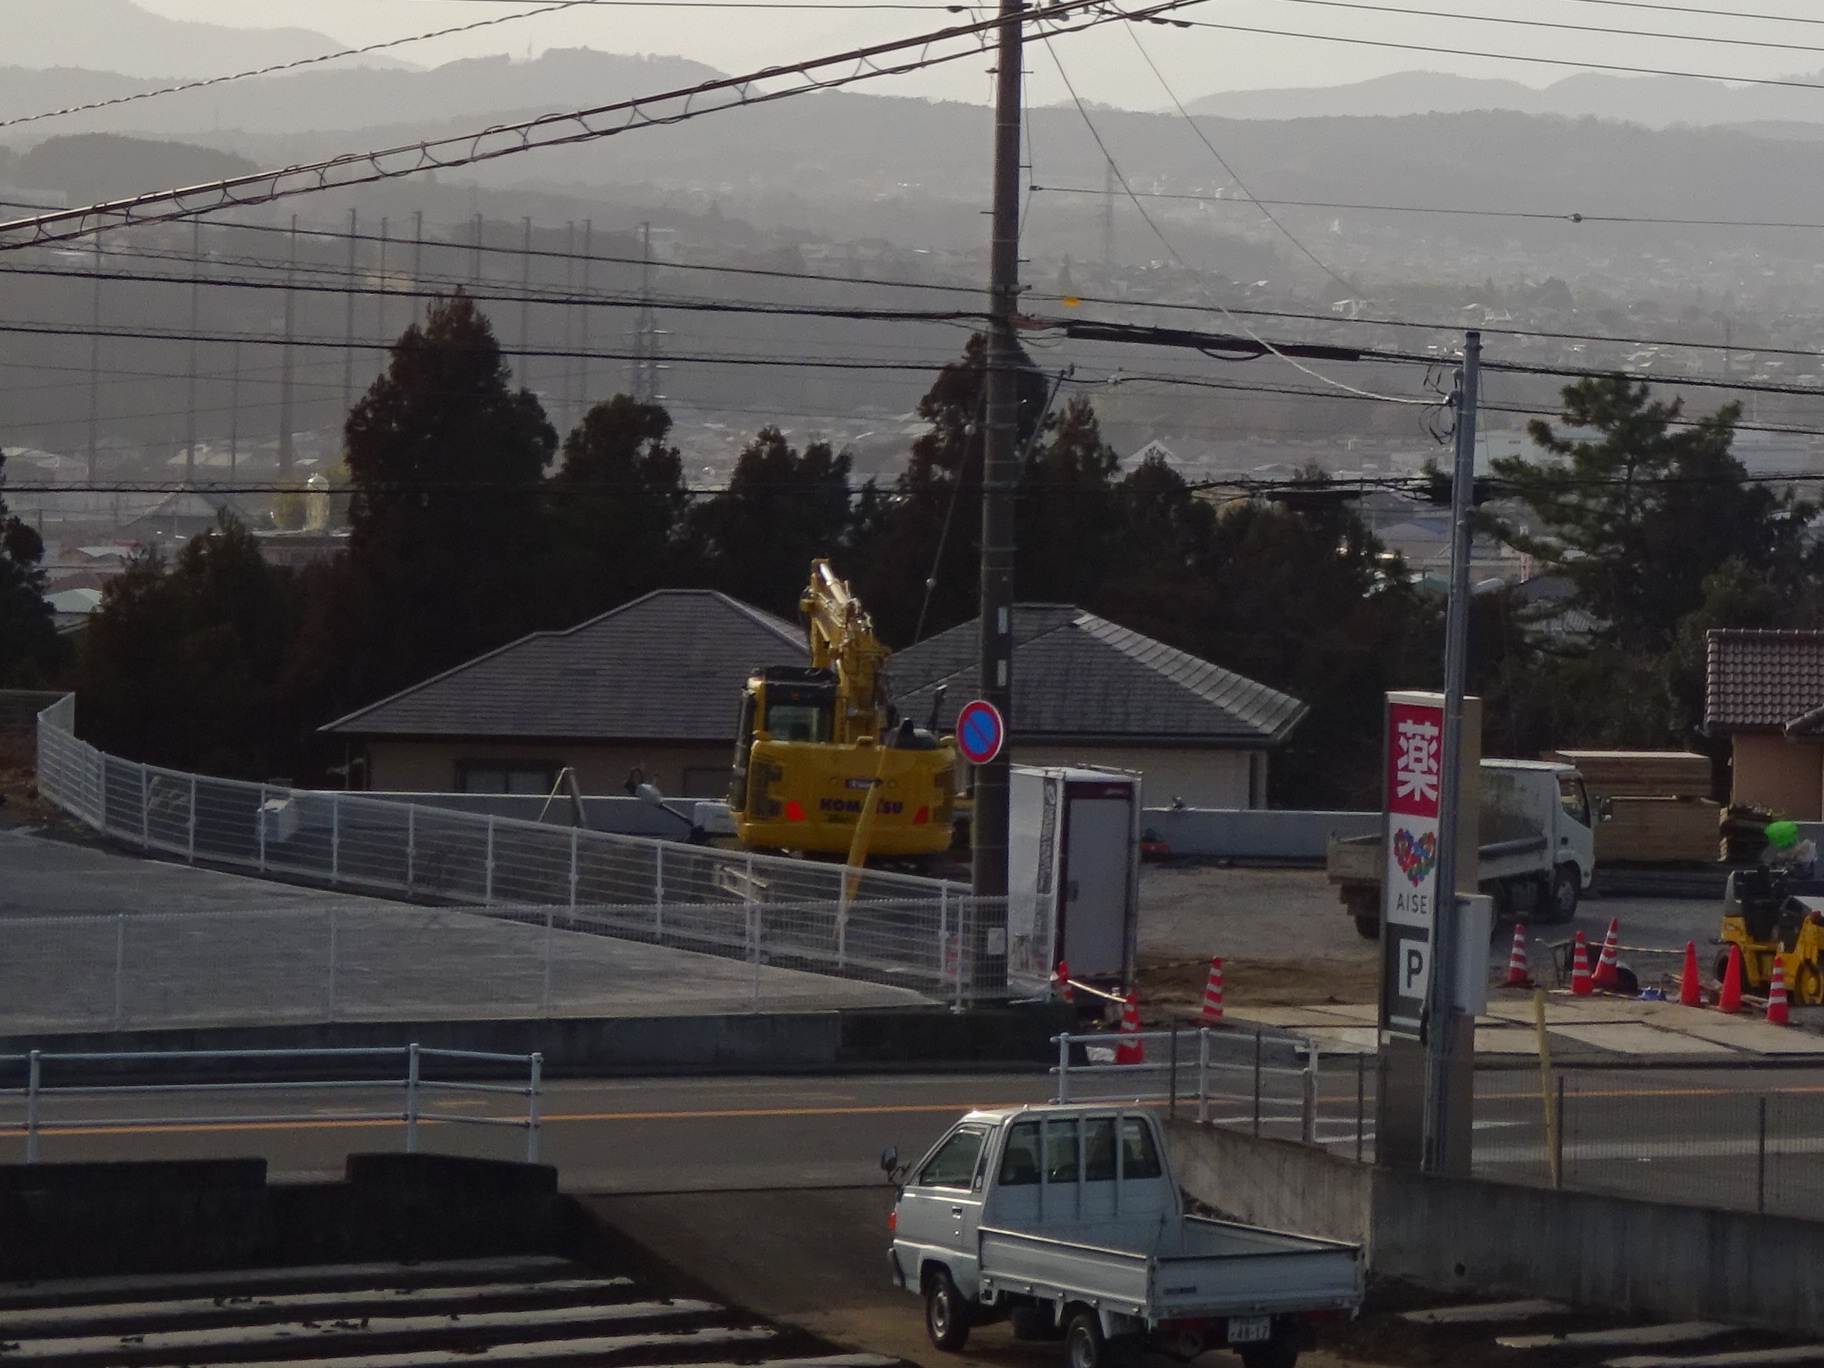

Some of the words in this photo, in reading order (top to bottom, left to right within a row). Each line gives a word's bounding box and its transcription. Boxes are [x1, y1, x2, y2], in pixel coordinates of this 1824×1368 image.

[1397, 719, 1439, 802] 薬
[820, 797, 904, 815] KOMSU
[1406, 948, 1424, 989] P
